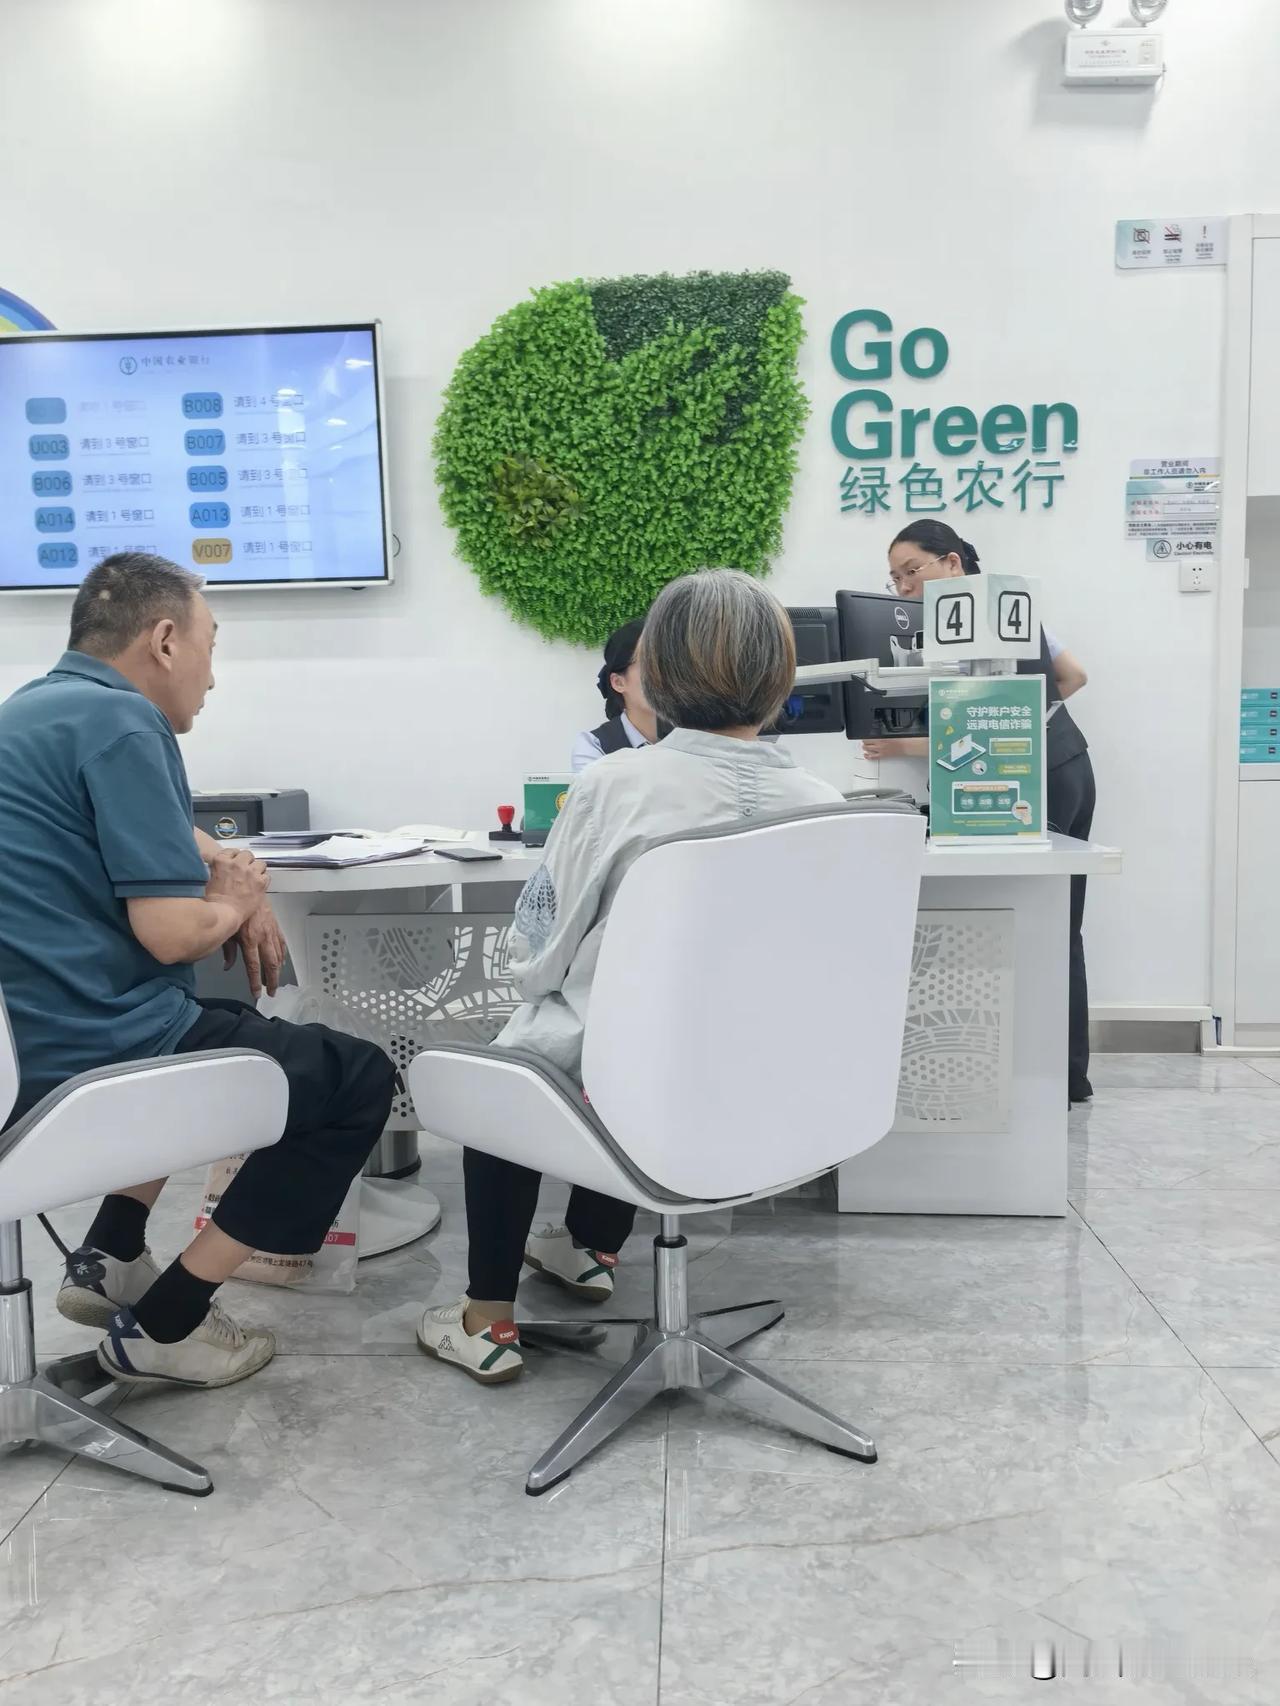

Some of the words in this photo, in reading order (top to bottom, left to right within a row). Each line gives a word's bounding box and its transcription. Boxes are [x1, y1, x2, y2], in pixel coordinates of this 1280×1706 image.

[830, 309, 949, 381] Go
[185, 398, 221, 413] B008
[831, 389, 1078, 460] Green
[187, 435, 224, 450] B007
[33, 476, 71, 491] B006
[190, 472, 227, 486] B005
[840, 459, 1064, 513] 绿色农行
[37, 512, 74, 527] A014
[191, 508, 229, 522] A013
[193, 543, 231, 558] V007
[1176, 541, 1212, 550] 小心有电
[40, 548, 77, 563] A012
[946, 600, 963, 637] 4
[1007, 598, 1022, 635] 4
[966, 706, 1032, 717] 守护账户安全
[966, 719, 1032, 730] 远离电信诈骗
